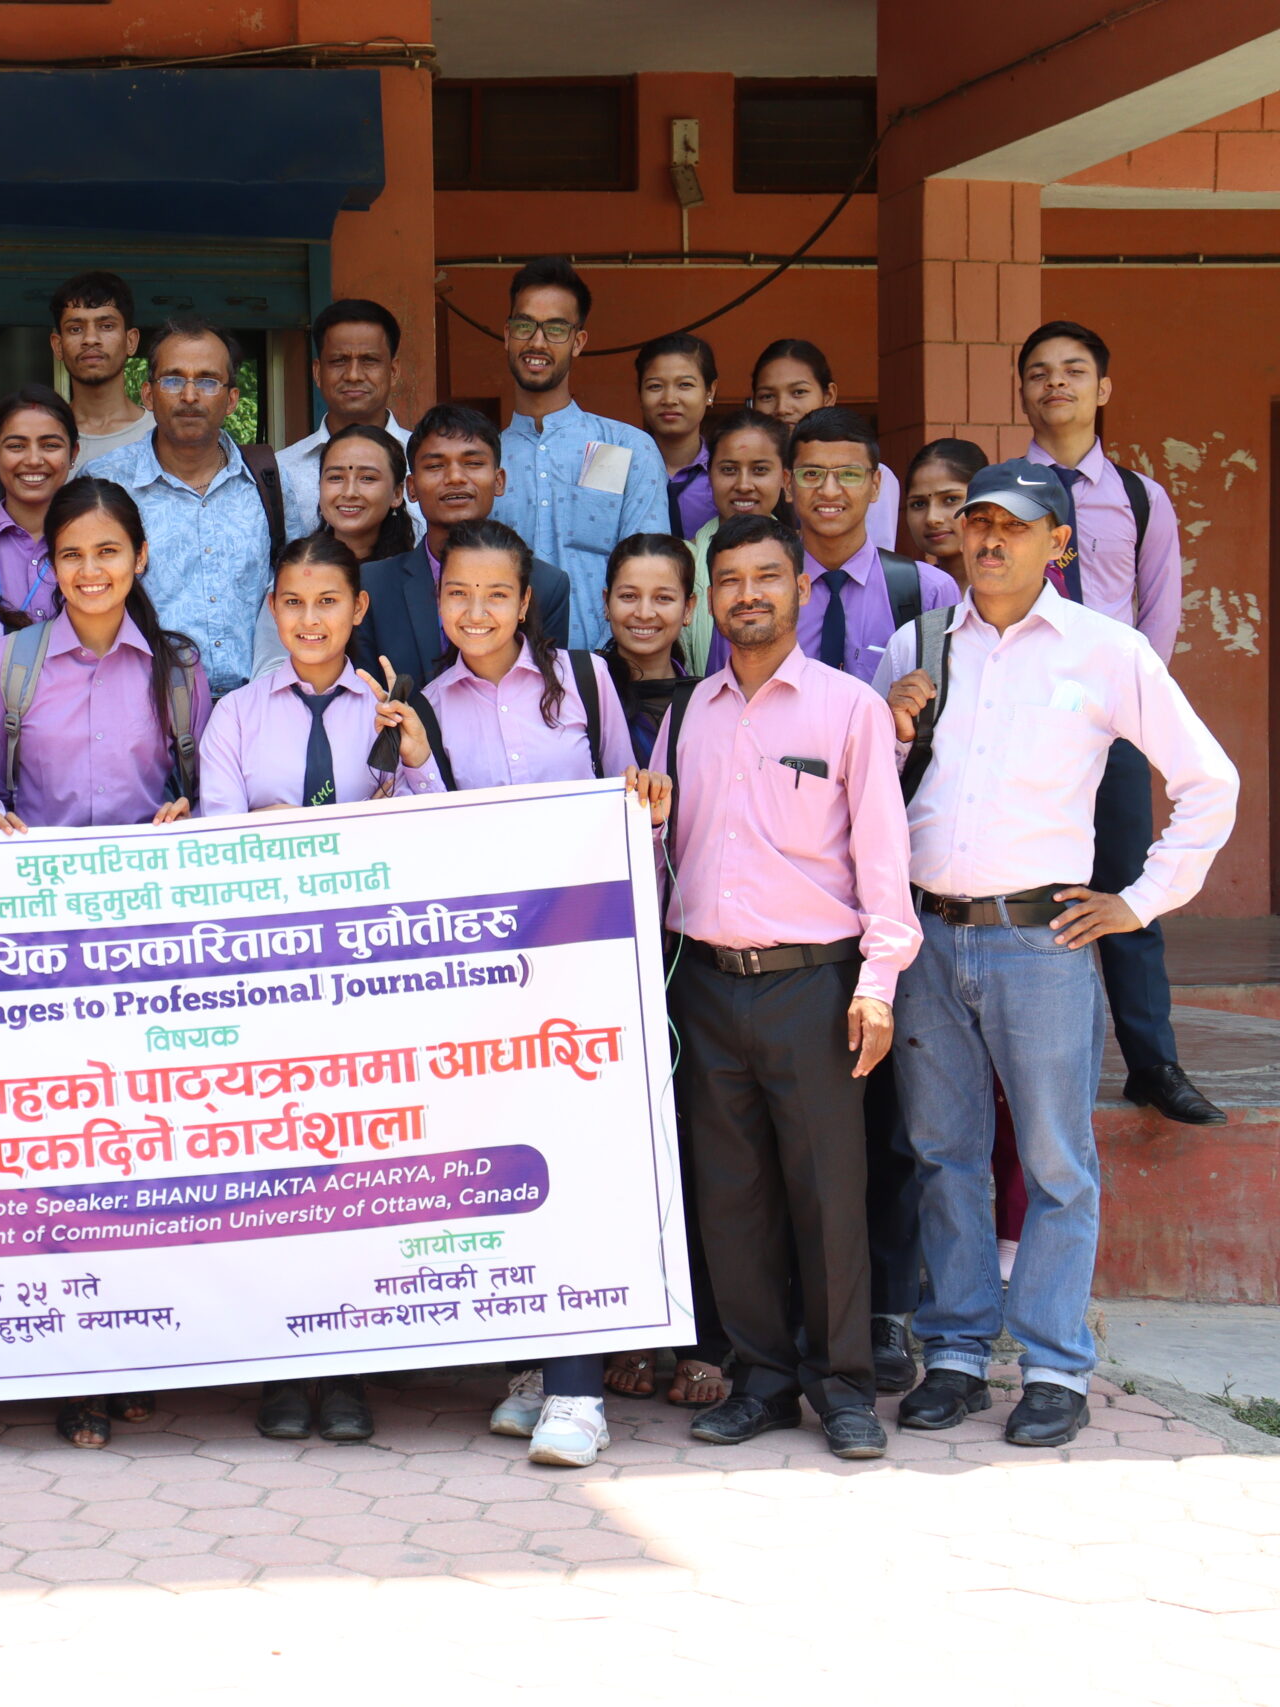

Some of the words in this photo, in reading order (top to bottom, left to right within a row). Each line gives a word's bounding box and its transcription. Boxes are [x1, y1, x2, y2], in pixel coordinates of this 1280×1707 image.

[1056, 547, 1078, 569] KMC
[310, 779, 334, 807] KMC
[16, 844, 169, 886] सुदूरपश्चिम
[177, 832, 341, 869] विश्वविद्यालय
[65, 881, 162, 922] बहुमुखी
[171, 876, 289, 908] क्याम्पस,
[297, 861, 391, 897] धनगढी
[80, 921, 324, 973] पत्रकारिताका
[73, 996, 106, 1020] to
[114, 975, 323, 1017] Professional
[331, 953, 532, 1006] Journalism)
[145, 1023, 241, 1053] विषयक
[124, 1046, 419, 1113] पाठ्यक्रममा
[427, 1017, 625, 1081] आधारित
[183, 1102, 427, 1159] कार्यशाला
[35, 1192, 129, 1217] Speaker:
[136, 1183, 219, 1209] BHANU
[225, 1176, 317, 1201] BHAKTA
[323, 1166, 436, 1193] ACHARYA,
[443, 1157, 492, 1180] Ph.D
[22, 1224, 45, 1245] of
[51, 1214, 222, 1242] Communication
[229, 1204, 337, 1232] University
[342, 1199, 365, 1218] of
[370, 1191, 452, 1216] Ottawa,
[459, 1182, 540, 1206] Canada
[399, 1229, 505, 1259] आयोजक
[16, 1281, 47, 1308] २५
[62, 1272, 101, 1299] गते
[374, 1263, 478, 1297] मानविकी
[489, 1264, 536, 1289] तथा
[77, 1307, 181, 1332] क्याम्पस,
[286, 1301, 461, 1337] सामाजिकशास्त्र
[472, 1291, 548, 1321] संकाय
[557, 1284, 629, 1312] विभाग
